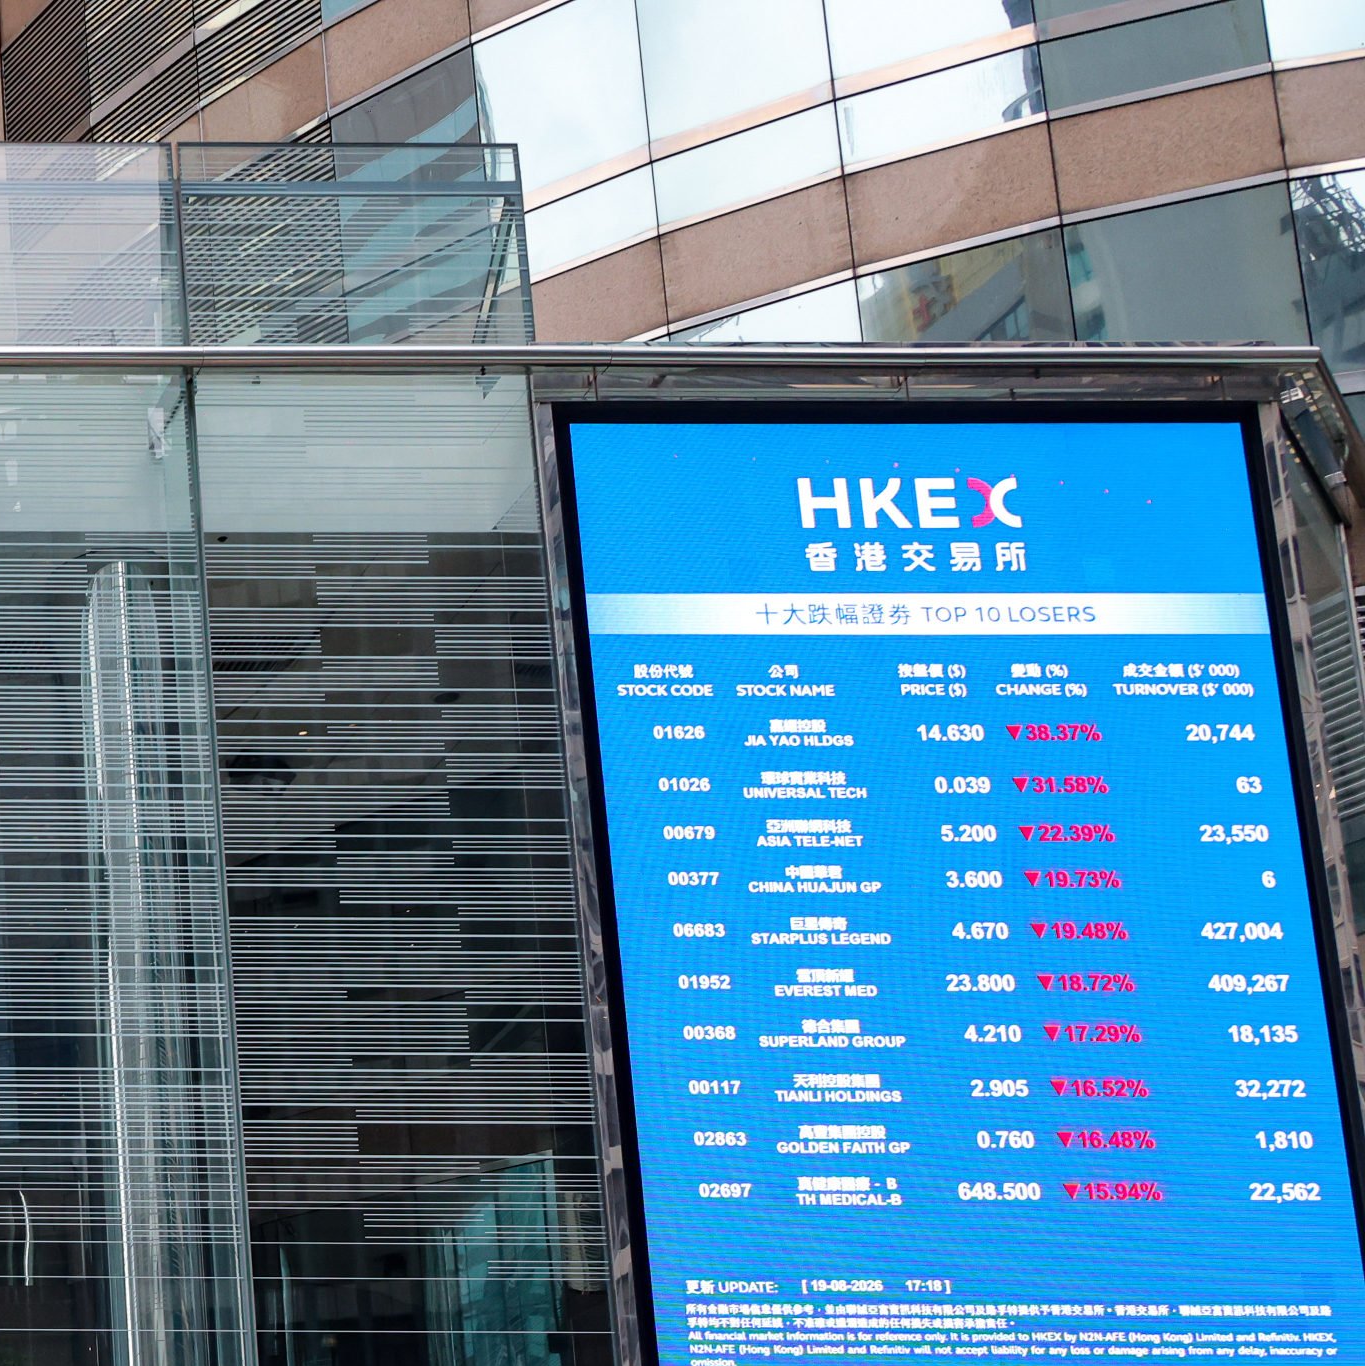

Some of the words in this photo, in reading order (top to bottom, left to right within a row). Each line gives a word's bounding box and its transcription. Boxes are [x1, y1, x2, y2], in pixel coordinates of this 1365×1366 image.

[798, 475, 1022, 528] HKEX
[806, 542, 1025, 571] 香港交易所
[757, 605, 909, 624] 十大跌幅證券
[925, 607, 966, 622] TOP
[976, 607, 1000, 621] 10
[1009, 607, 1095, 622] LOSERS
[618, 685, 667, 696] STOCK
[671, 685, 713, 696] CODE
[737, 685, 786, 696] STOCK
[790, 685, 835, 696] NAME
[901, 684, 945, 695] PRICE
[996, 684, 1061, 695] CHANGE
[1113, 684, 1198, 695] TURNOVER
[654, 726, 705, 739] 01626
[917, 725, 984, 741] 14.630
[1028, 724, 1102, 740] 38.37%
[1186, 725, 1255, 743] 20,744
[745, 735, 766, 746] JIA
[769, 735, 800, 746] YAO
[804, 735, 853, 746] HLDGS
[659, 778, 710, 791] 01026
[935, 777, 990, 793] 0.039
[1034, 776, 1108, 793] 31.58%
[1237, 777, 1262, 793] 63
[744, 787, 825, 798] UNIVERSAL
[828, 788, 867, 798] TECH
[664, 826, 715, 839] 00679
[942, 825, 996, 841] 5.200
[1040, 824, 1115, 842] 22.39%
[1200, 825, 1268, 844] 23,550
[757, 836, 791, 846] ASIA
[794, 836, 863, 846] TELE-NET
[668, 872, 719, 885] 00377
[946, 871, 1002, 887] 3.600
[1047, 871, 1121, 888] 19.73%
[1262, 871, 1275, 888] 6
[749, 882, 794, 892] CHINA
[797, 882, 856, 892] HUAJUN
[861, 882, 881, 892] GP
